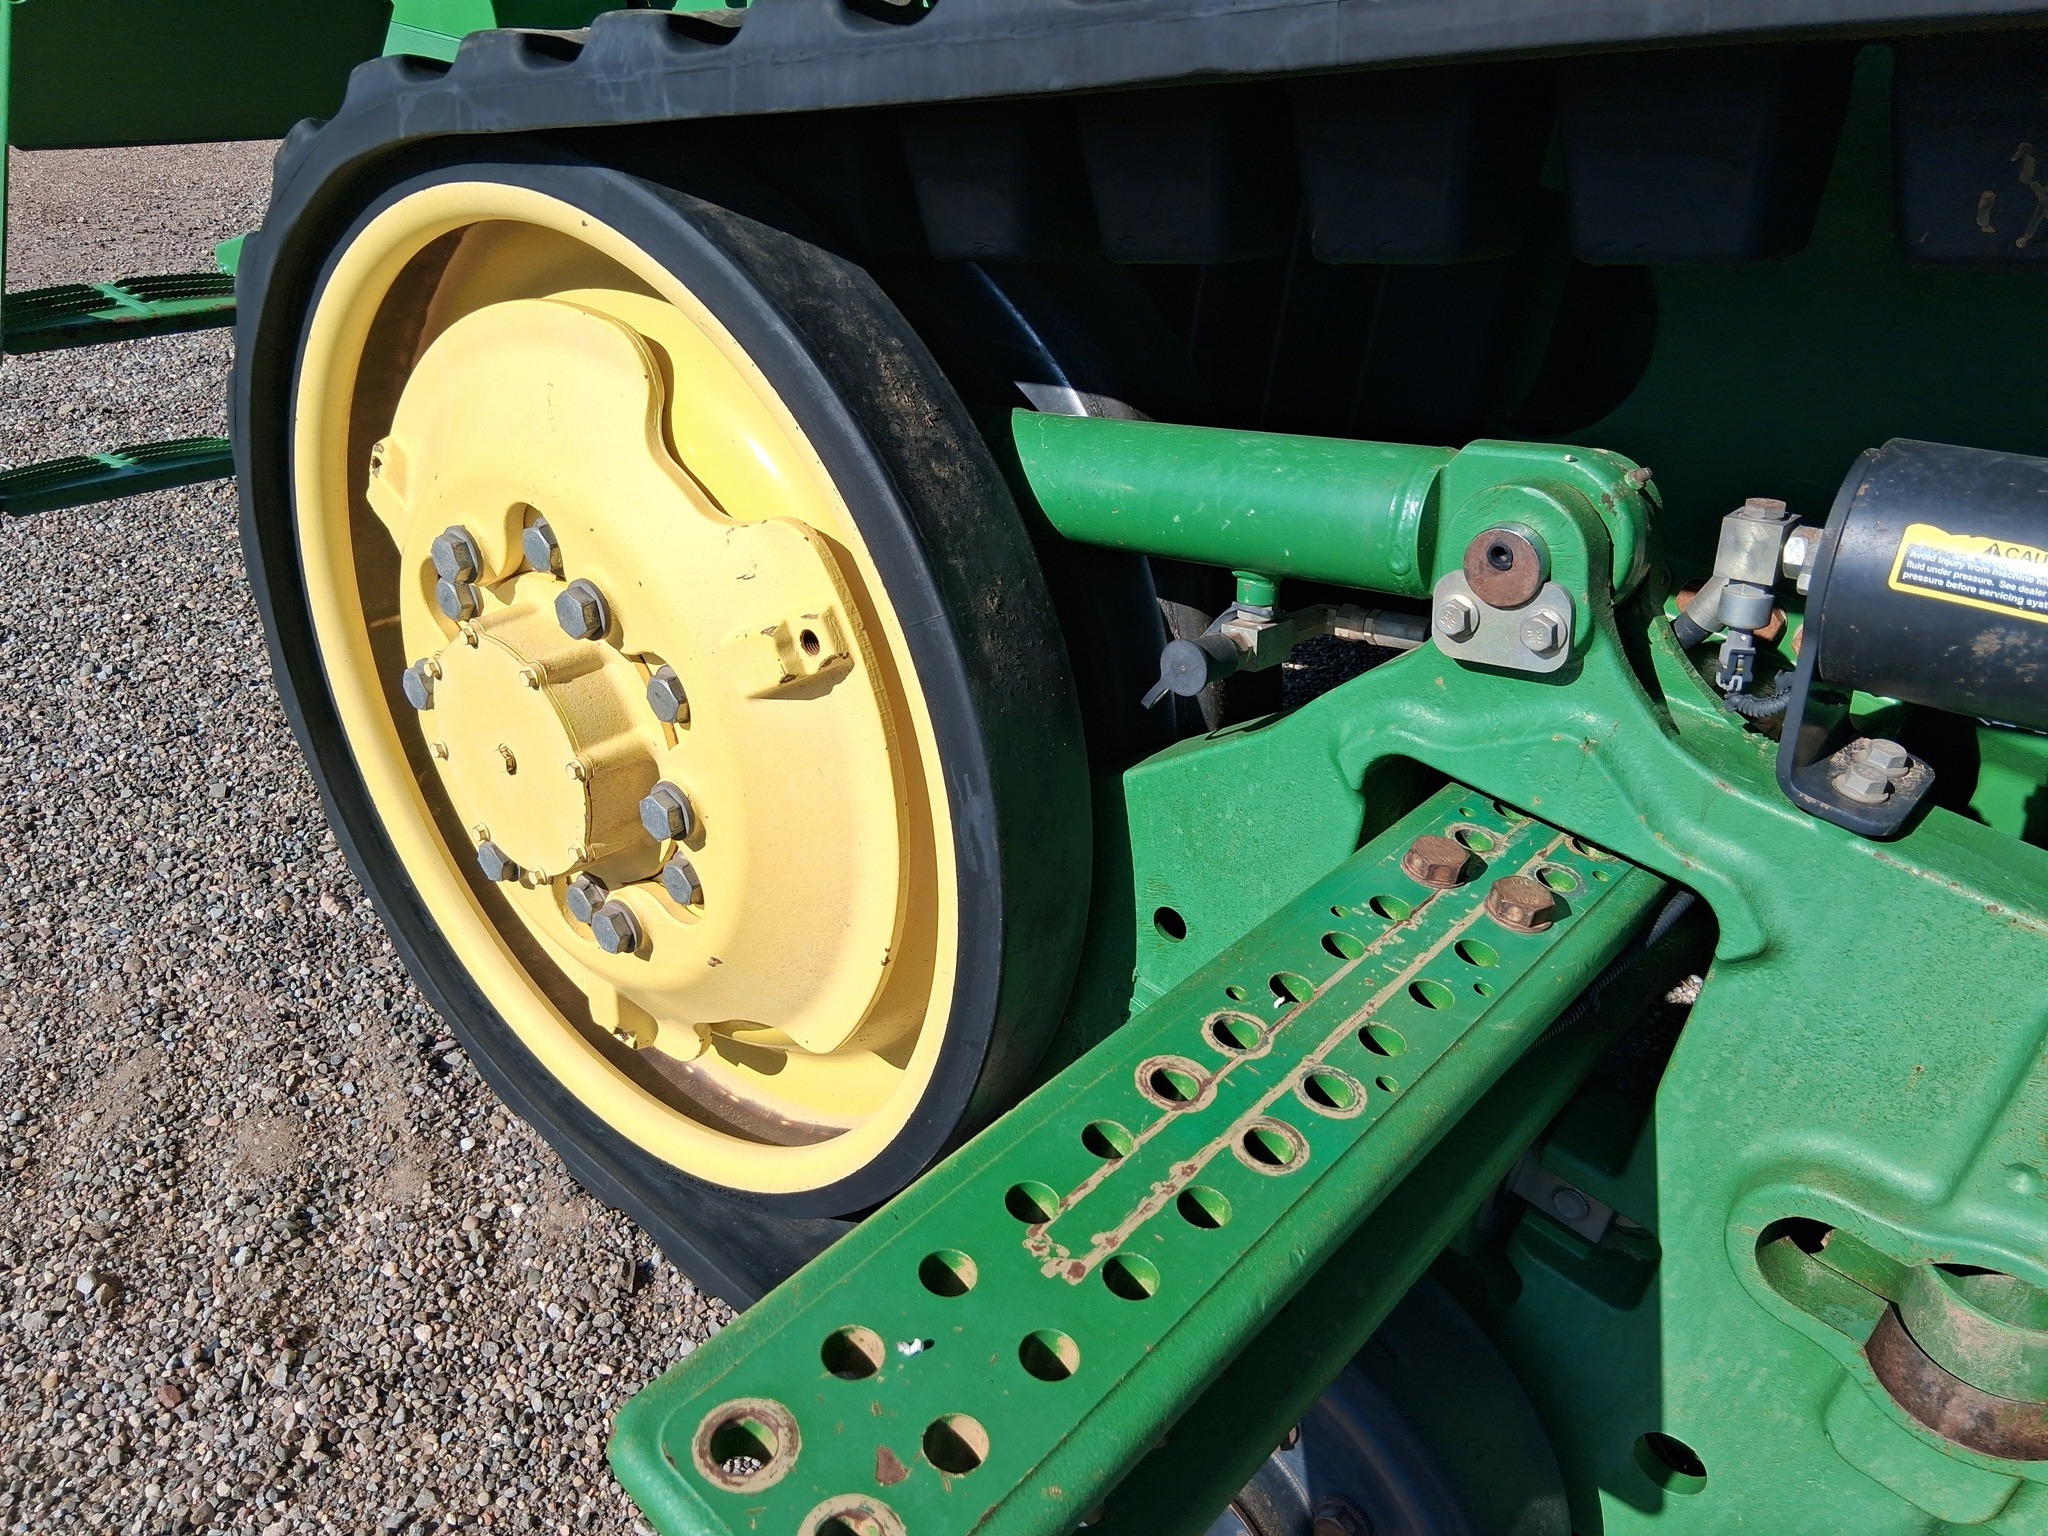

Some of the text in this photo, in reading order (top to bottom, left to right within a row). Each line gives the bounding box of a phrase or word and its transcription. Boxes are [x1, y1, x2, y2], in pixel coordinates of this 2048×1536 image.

[1906, 560, 2047, 597] fluid under pressure. See dealer
[1910, 550, 1937, 562] Avoid
[1938, 555, 1966, 568] injury
[1967, 561, 1990, 574] from
[1992, 567, 2034, 584] machine
[1902, 571, 1944, 586] pressure
[1945, 579, 1977, 593] before
[1978, 588, 2024, 605] servicing
